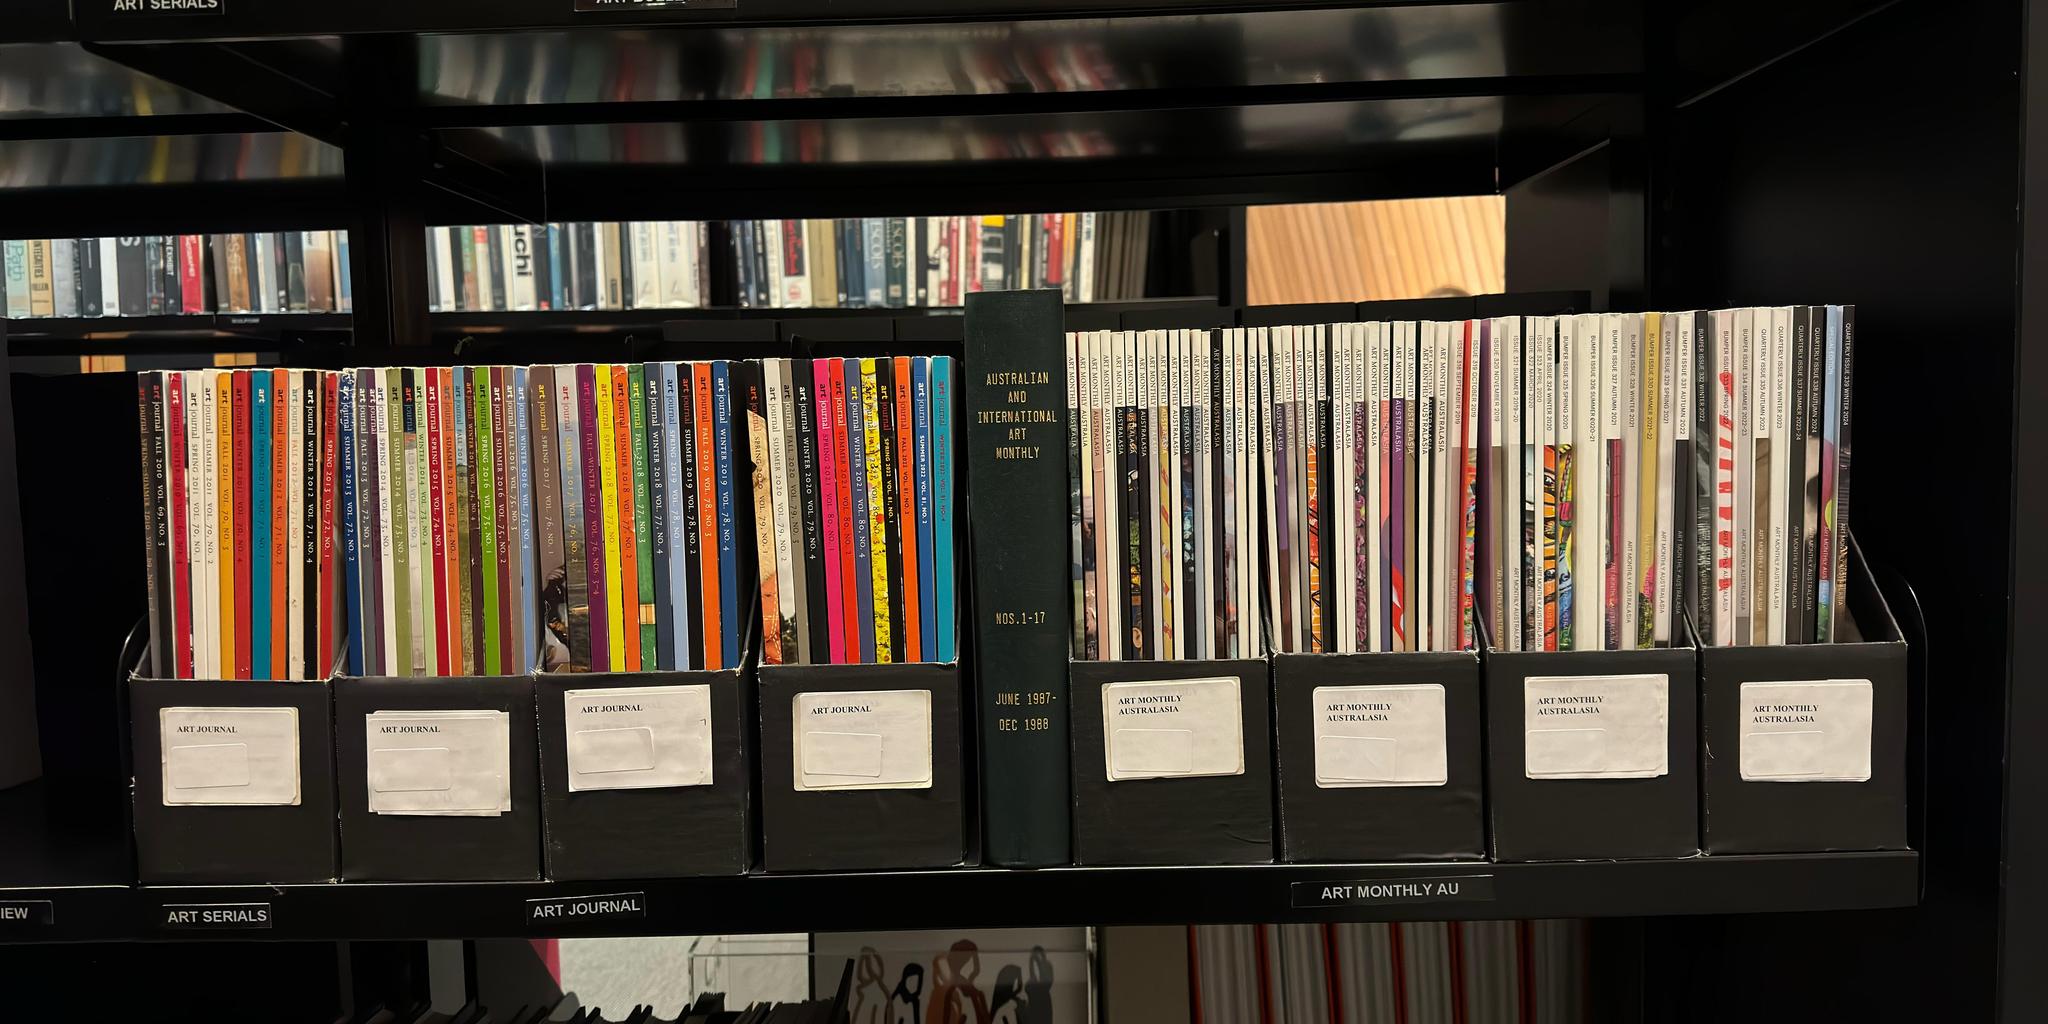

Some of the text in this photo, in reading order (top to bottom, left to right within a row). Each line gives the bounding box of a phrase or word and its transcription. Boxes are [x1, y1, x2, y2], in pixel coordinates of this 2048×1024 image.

[12, 246, 25, 281] Path
[987, 372, 1048, 385] AUSTRALIAN
[1008, 391, 1026, 403] AND
[479, 401, 488, 430] journal
[681, 395, 690, 424] journal
[716, 395, 727, 423] journal
[917, 399, 926, 427] journal
[153, 402, 162, 431] journal
[306, 406, 315, 435] journal
[798, 403, 809, 432] journal
[978, 410, 1057, 423] INTERNATIONAL
[1009, 428, 1026, 440] ART
[996, 447, 1040, 459] MONTHLY
[996, 612, 1045, 624] NOS.1-17
[996, 693, 1020, 705] JUNE
[1138, 695, 1182, 704] MONTHLY
[601, 704, 642, 712] JOURNAL
[831, 706, 871, 714] JOURNAL
[1119, 706, 1179, 715] AUSTRALASIA
[1537, 707, 1599, 715] AUSTRALASIA
[1000, 719, 1017, 730] DEC
[1322, 883, 1459, 899] ART MONTHLY AU
[534, 899, 640, 918] ART JOURNAL
[168, 910, 267, 923] ART SERIALS
